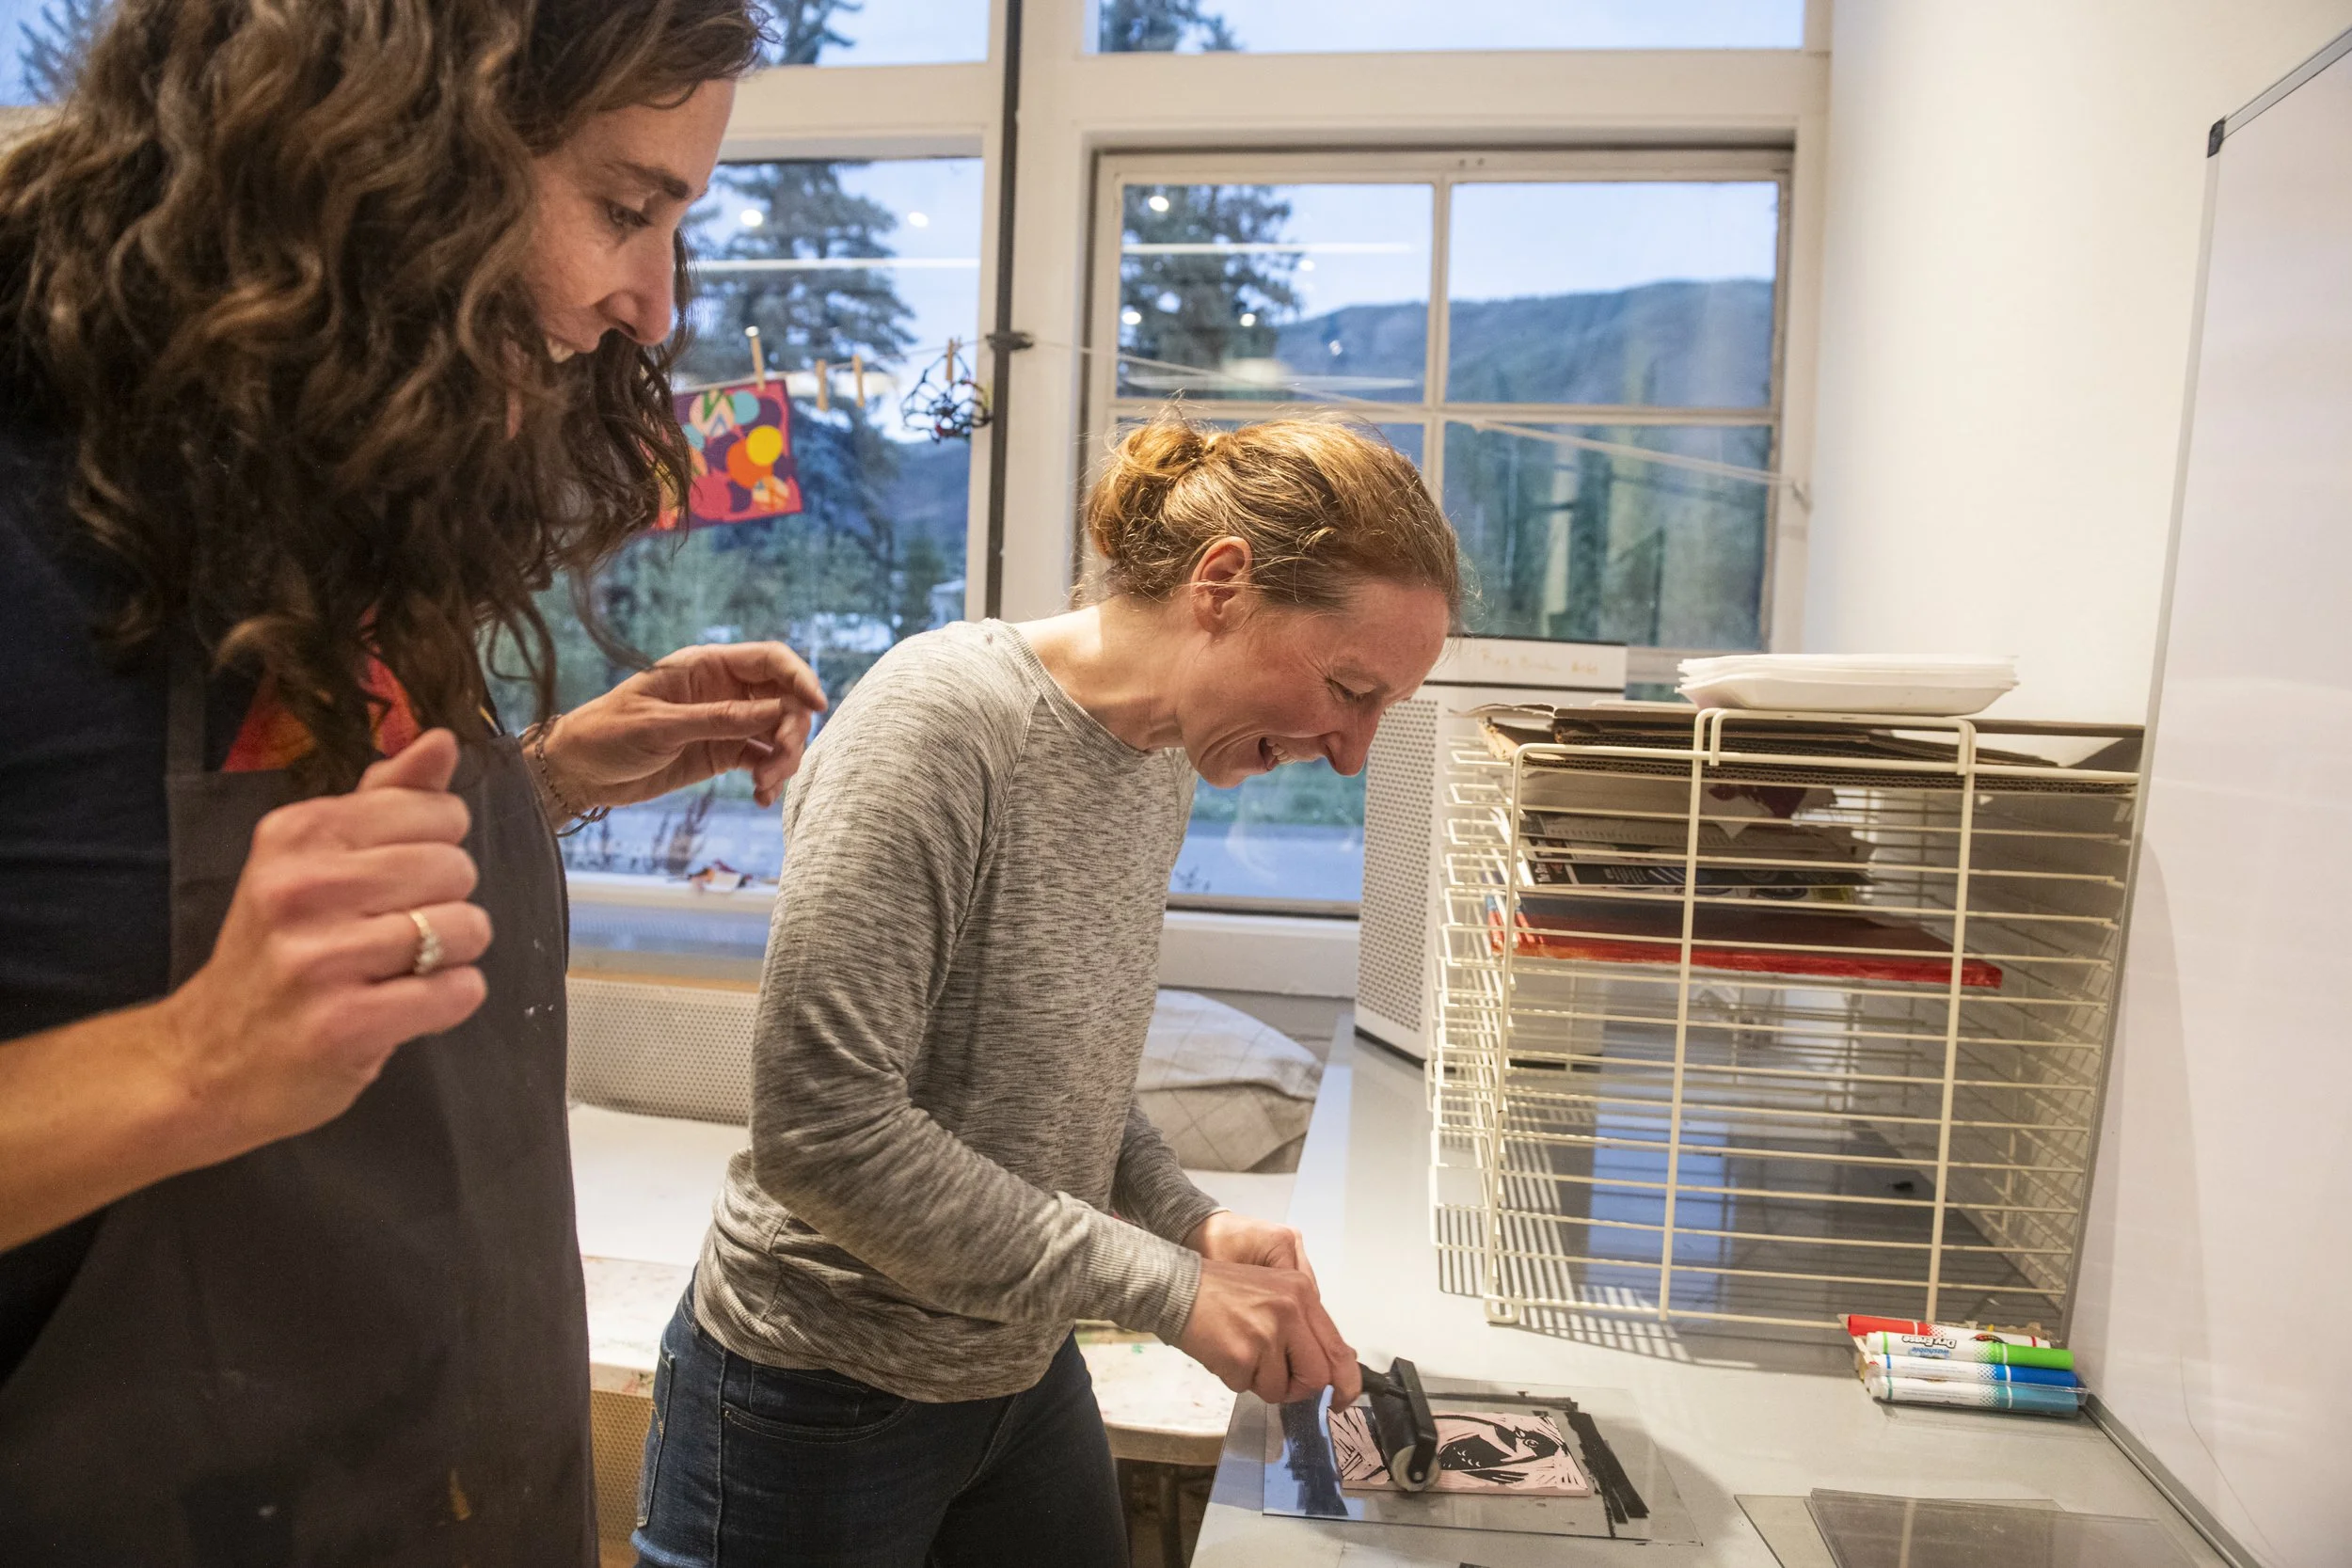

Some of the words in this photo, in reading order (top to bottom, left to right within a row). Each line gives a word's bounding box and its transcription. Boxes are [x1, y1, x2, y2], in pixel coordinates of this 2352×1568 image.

[1902, 1336, 1934, 1347] Erase
[1934, 1338, 1957, 1349] Dry
[1912, 1347, 1949, 1355] washable
